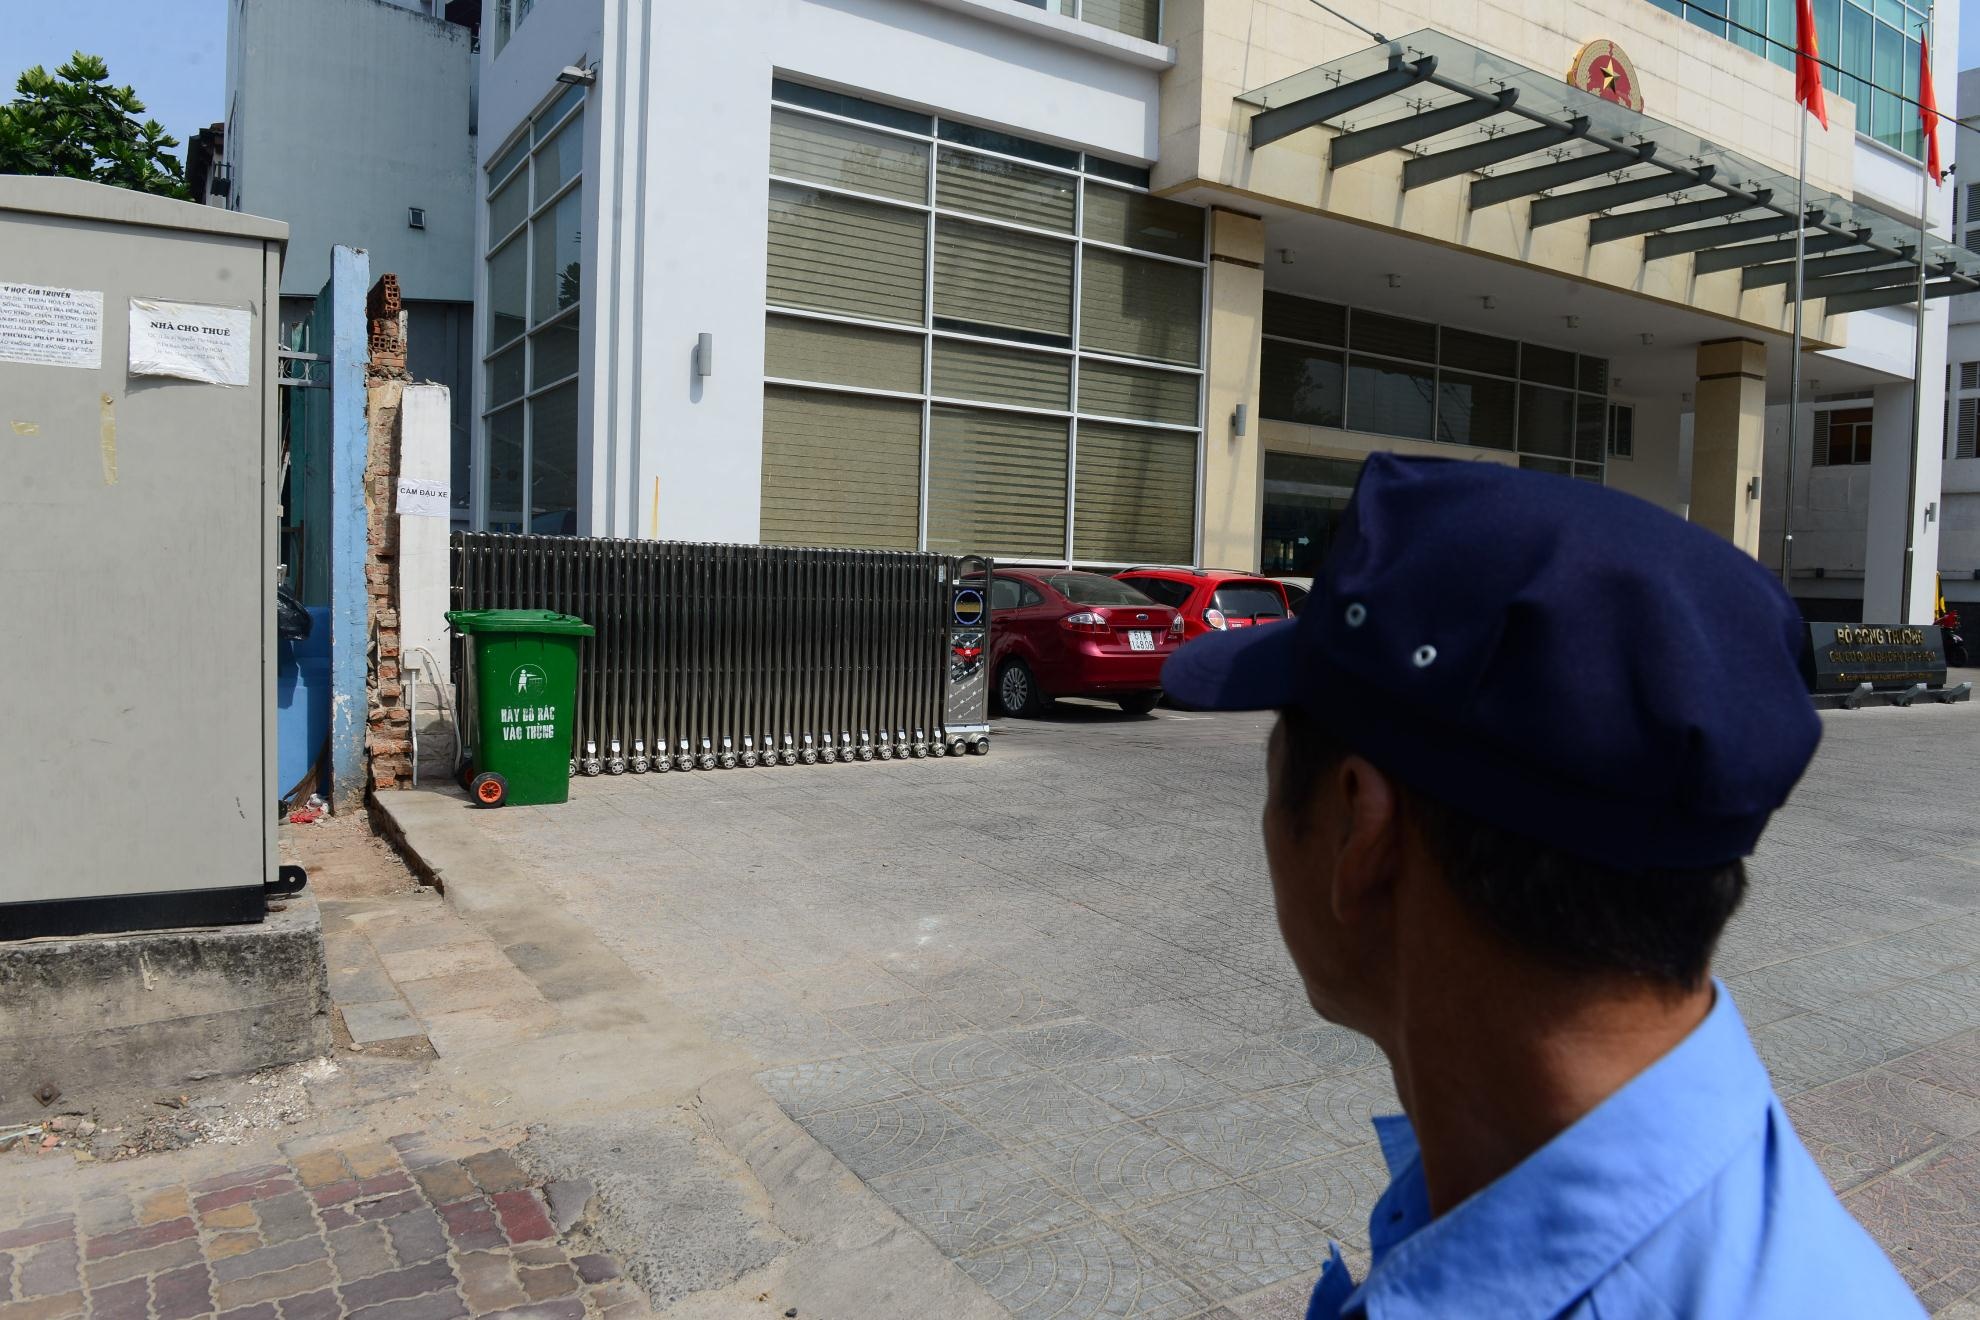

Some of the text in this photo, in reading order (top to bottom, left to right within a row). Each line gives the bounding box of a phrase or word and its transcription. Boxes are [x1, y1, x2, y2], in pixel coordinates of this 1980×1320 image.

[11, 286, 26, 295] HỌC
[28, 288, 40, 296] GIA
[150, 321, 231, 337] NHÀ CHO THUÊ
[522, 704, 535, 721] BỎ
[537, 704, 555, 721] RÁC
[503, 722, 554, 740] VÀO THÙNG
